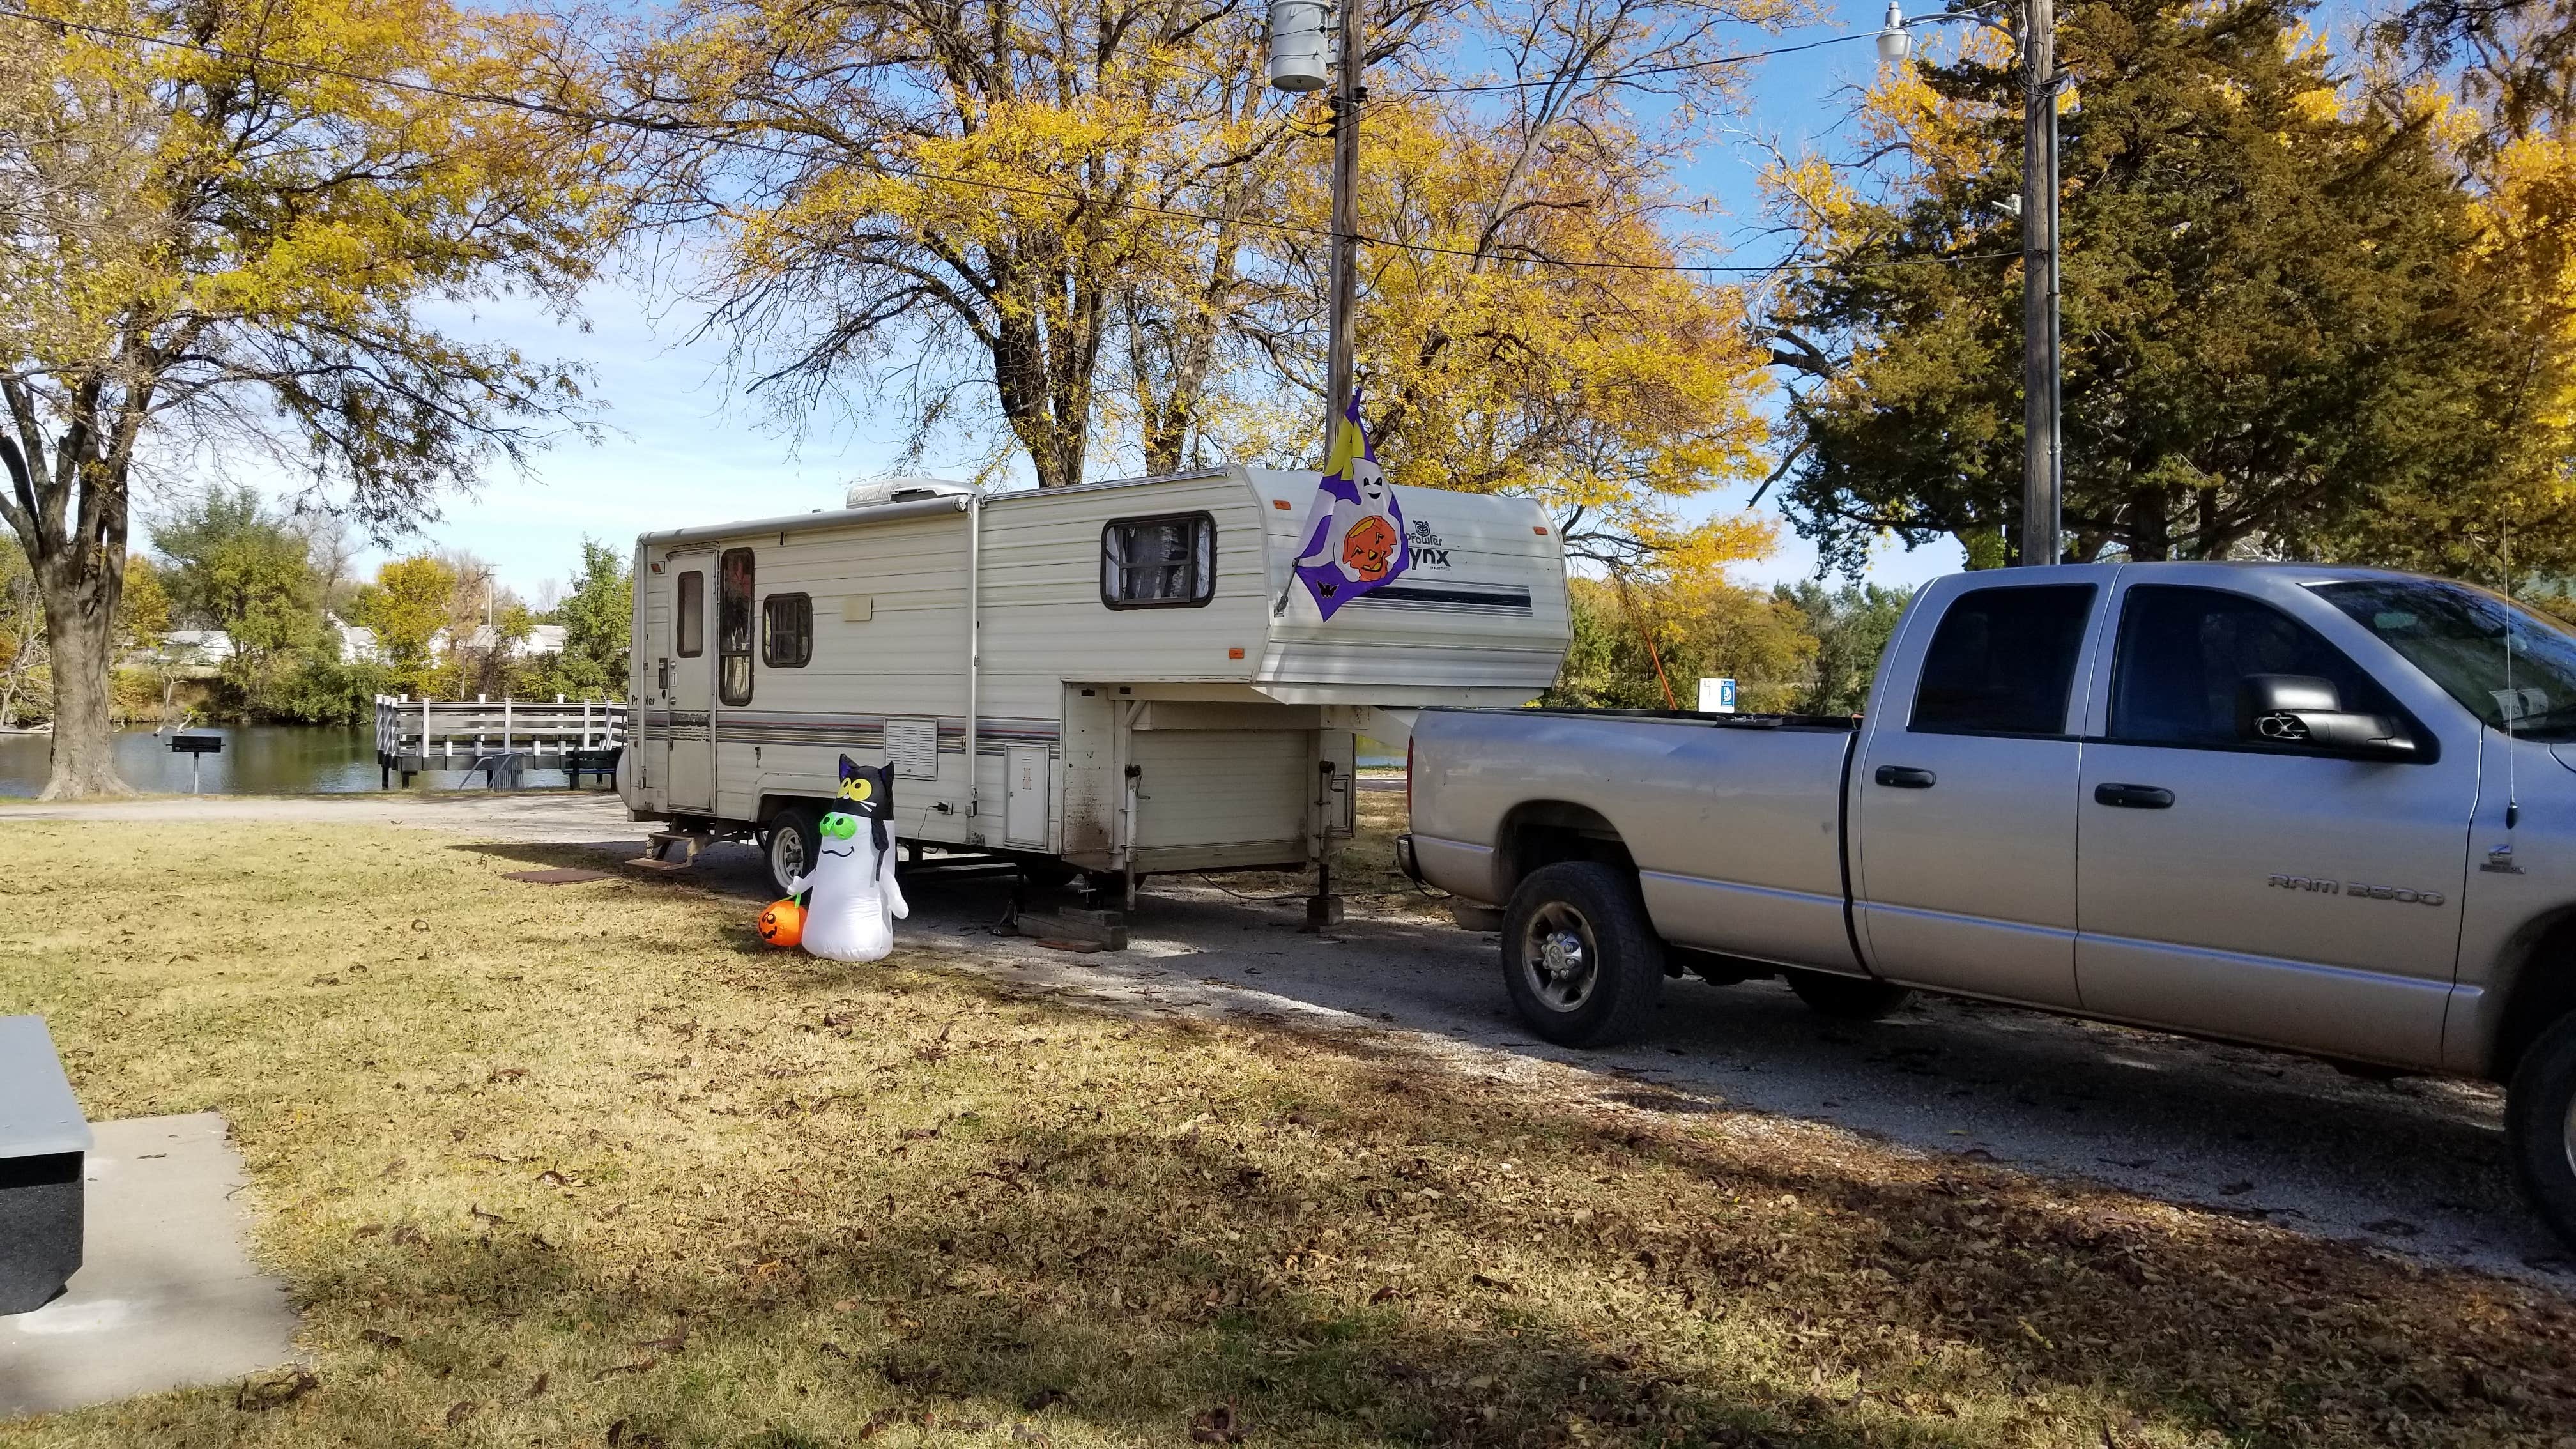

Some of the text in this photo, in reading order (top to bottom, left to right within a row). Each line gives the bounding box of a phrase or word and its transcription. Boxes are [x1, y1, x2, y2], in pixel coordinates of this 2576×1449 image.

[1408, 548, 1452, 571] ynx
[632, 695, 654, 705] Prler
[2267, 873, 2338, 894] RAM
